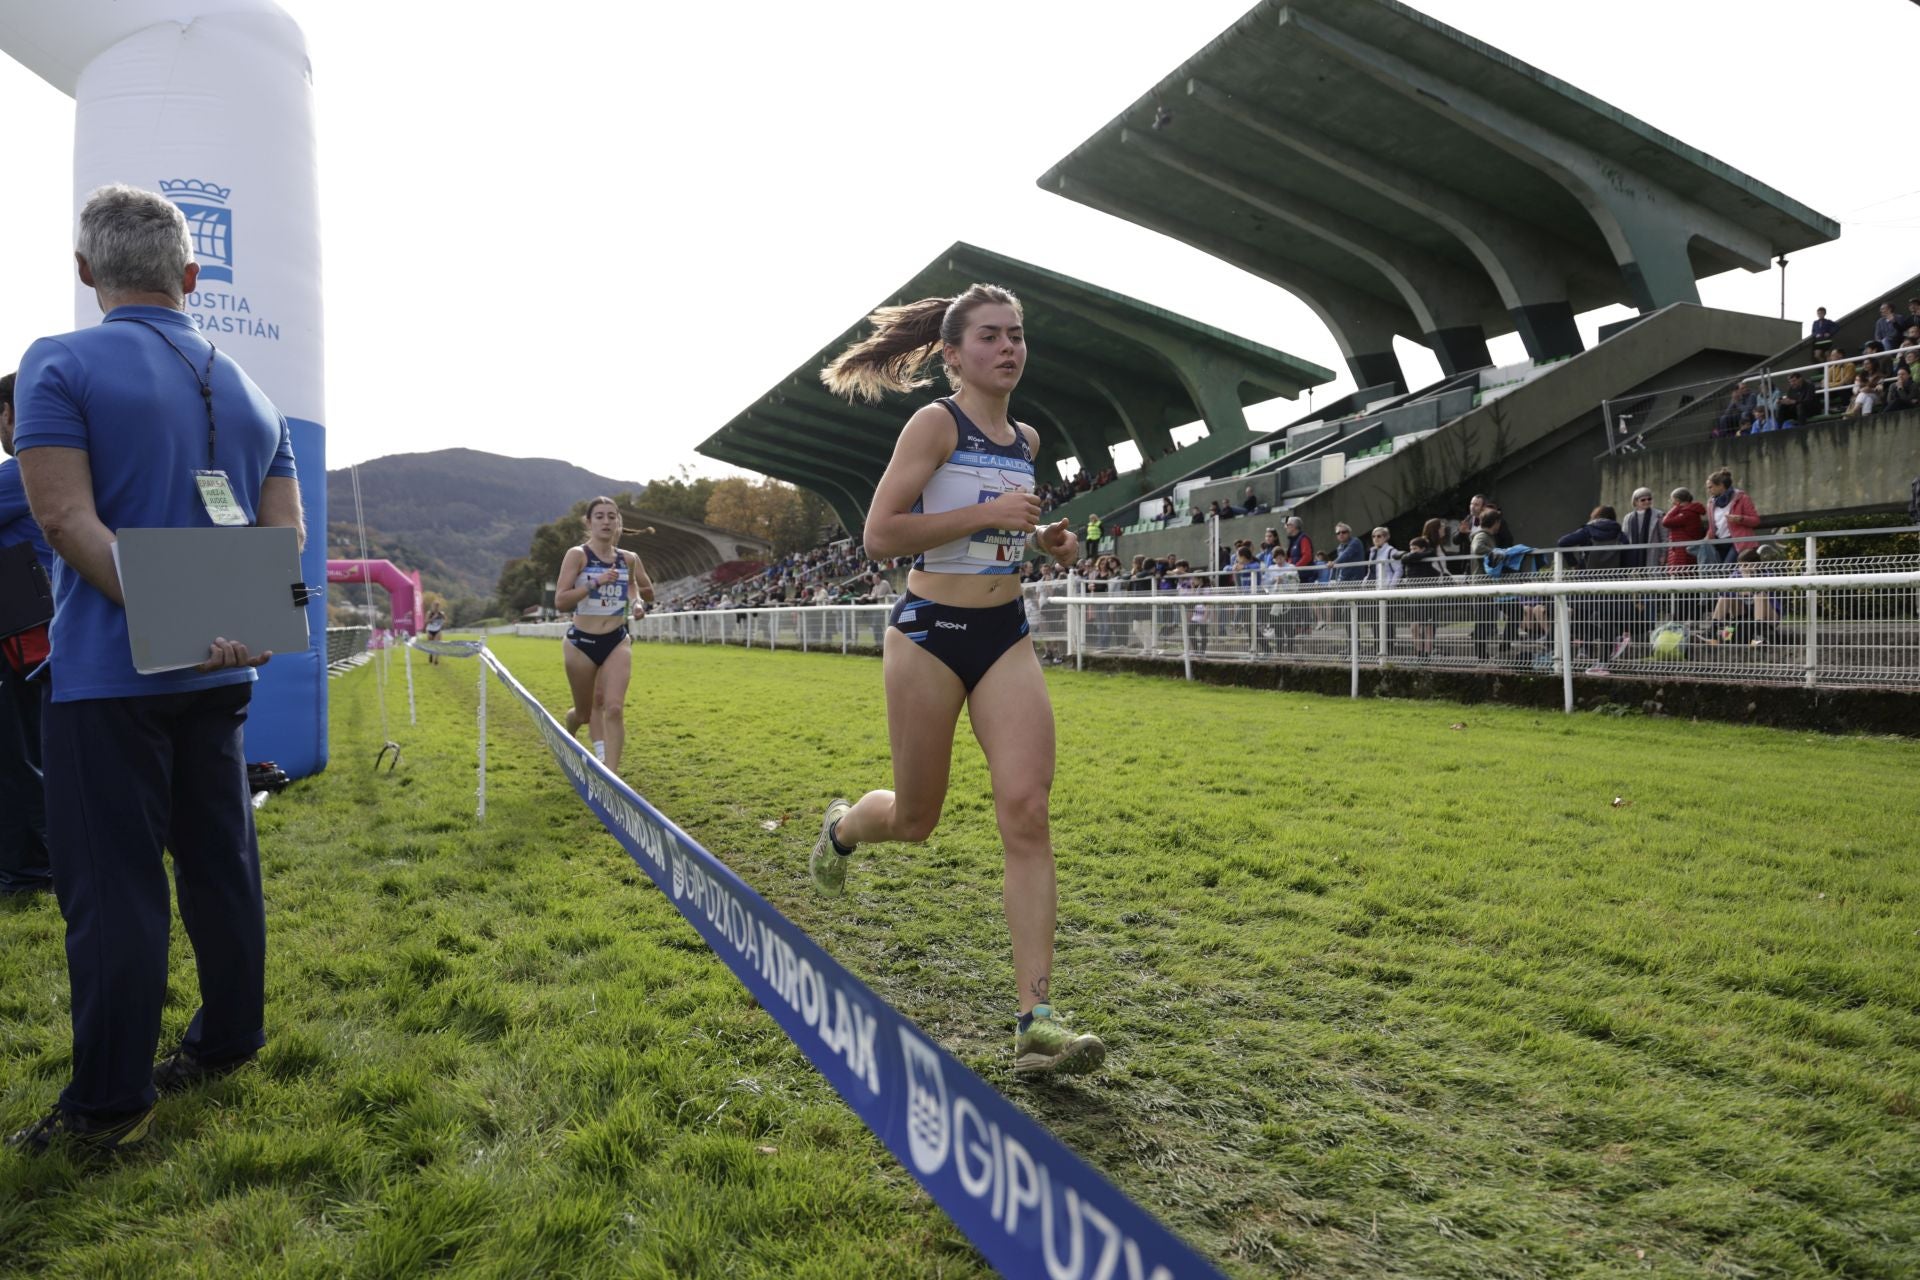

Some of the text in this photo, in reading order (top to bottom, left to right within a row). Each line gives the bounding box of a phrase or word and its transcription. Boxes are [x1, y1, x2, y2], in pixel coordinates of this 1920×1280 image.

[188, 291, 251, 314] OSTIA
[191, 313, 279, 341] BASTIÁN
[598, 585, 623, 597] 408
[682, 853, 761, 972] GIPUZKOA
[758, 919, 881, 1096] KIROLAK
